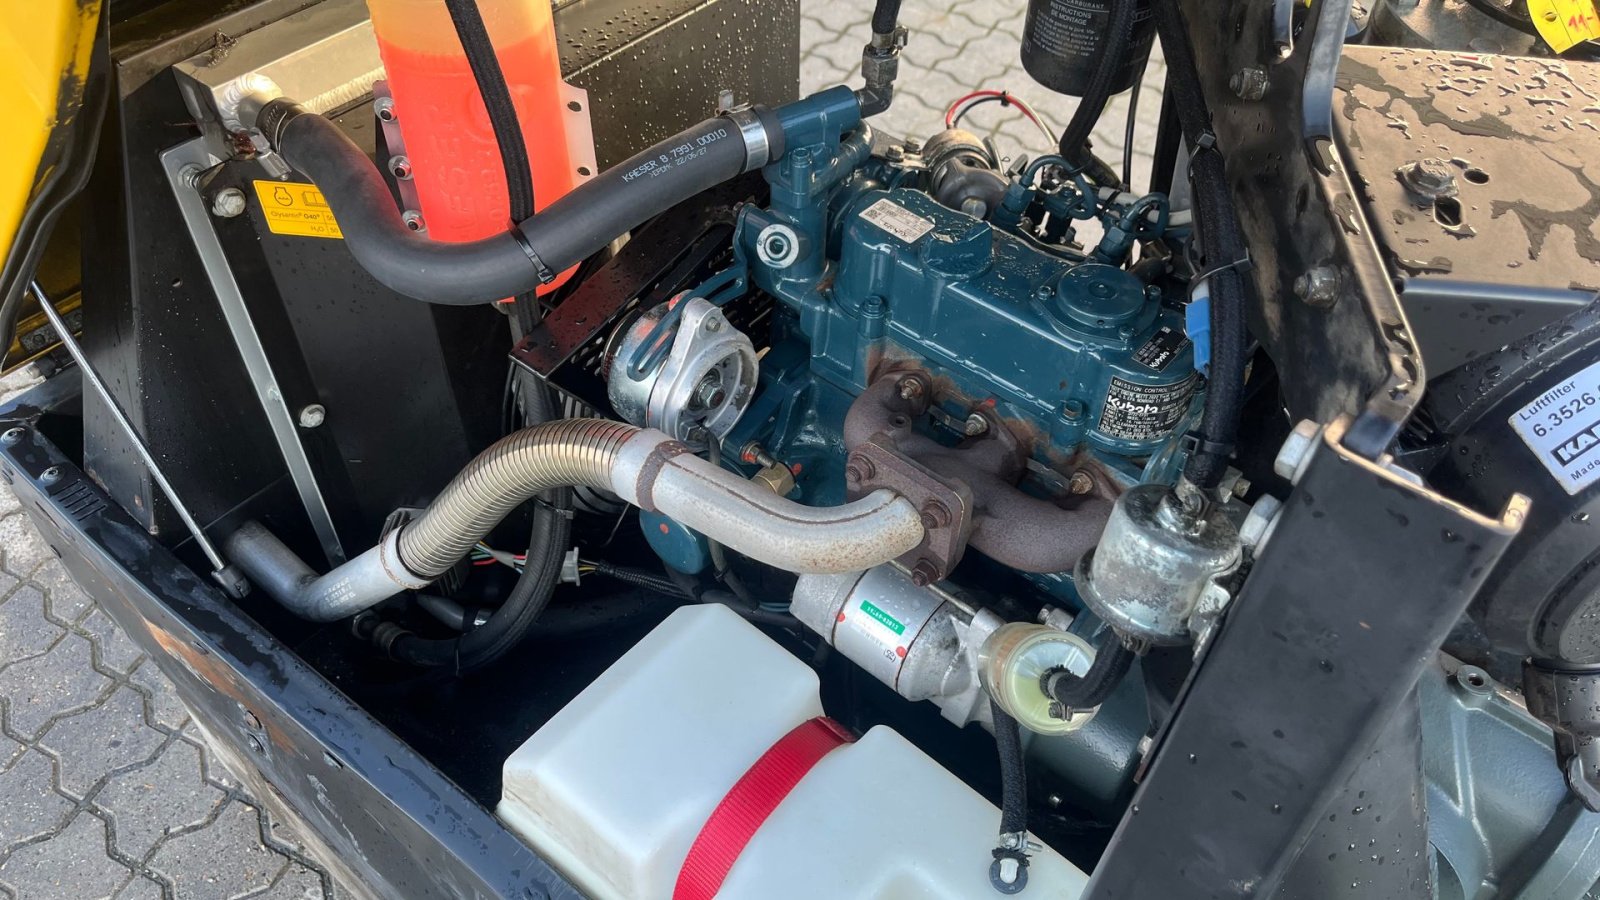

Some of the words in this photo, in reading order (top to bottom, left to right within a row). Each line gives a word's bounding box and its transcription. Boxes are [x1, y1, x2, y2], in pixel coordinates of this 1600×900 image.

[1050, 1, 1091, 19] INSTRUCTIONS
[1051, 9, 1059, 18] DE
[1059, 13, 1087, 26] MONTAGE
[621, 159, 659, 183] KAESER
[1113, 379, 1142, 393] EMISSION
[1107, 394, 1159, 414] Kubota
[1519, 381, 1576, 421] Luftfilter
